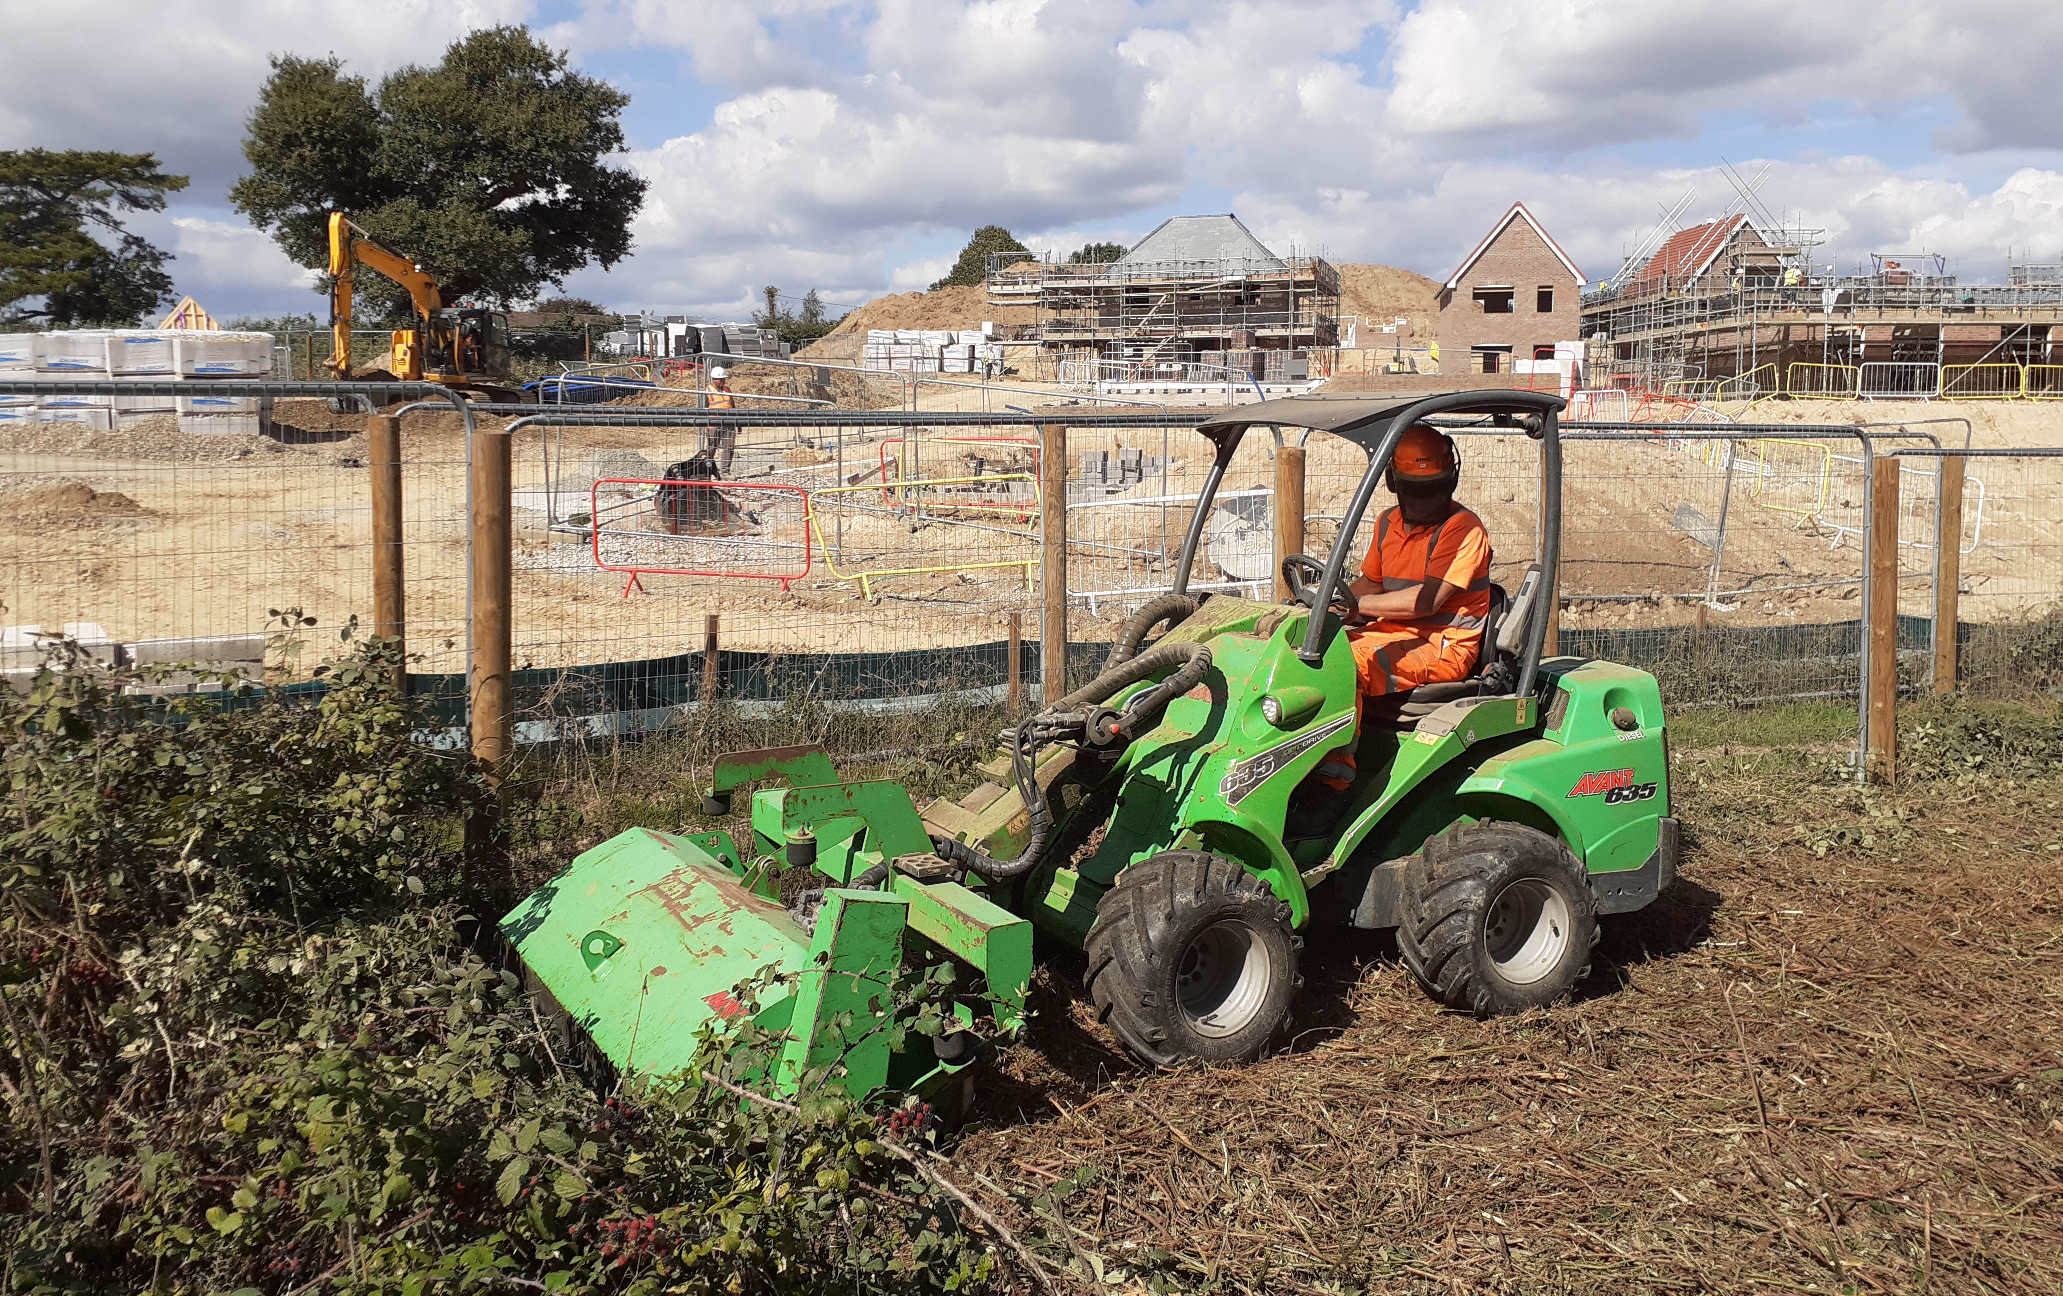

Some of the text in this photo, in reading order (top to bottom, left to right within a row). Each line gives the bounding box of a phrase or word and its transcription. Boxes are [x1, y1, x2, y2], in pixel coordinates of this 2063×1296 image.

[1618, 732, 1643, 742] DIESEL
[1219, 755, 1275, 794] 635
[1567, 770, 1634, 797] AVANT
[1604, 782, 1658, 805] 635
